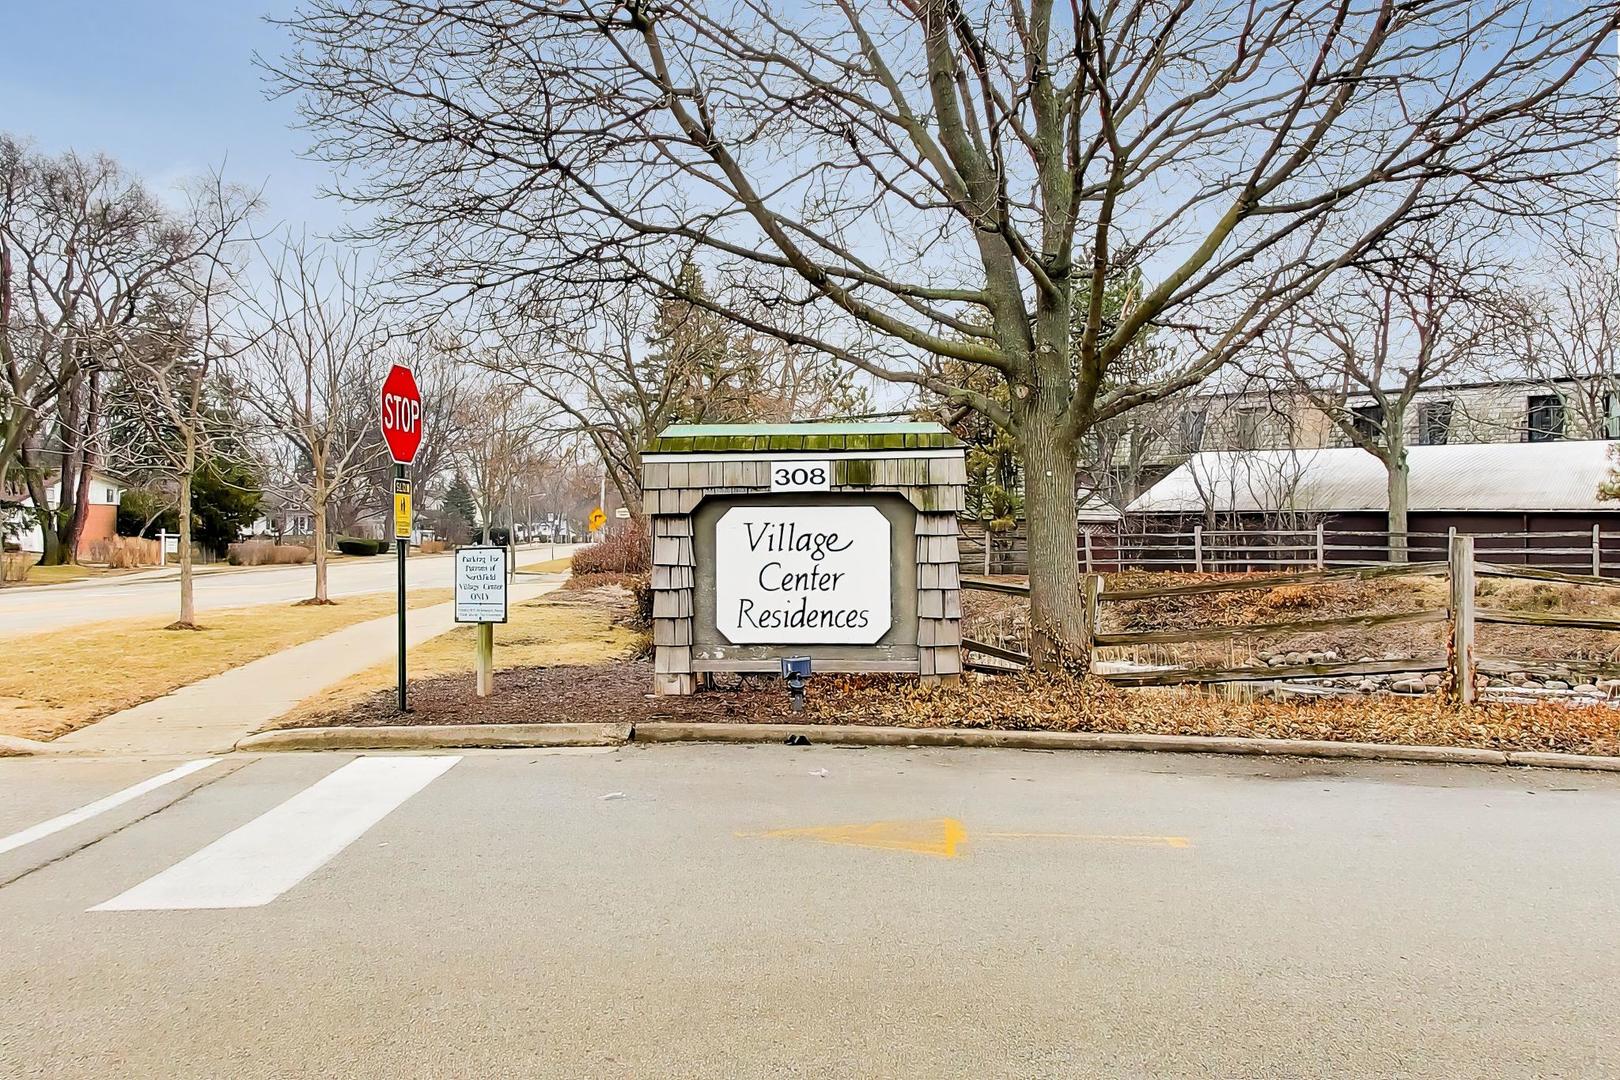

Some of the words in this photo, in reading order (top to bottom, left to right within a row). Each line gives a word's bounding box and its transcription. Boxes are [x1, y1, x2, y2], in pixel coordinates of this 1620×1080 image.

[384, 392, 419, 431] STOP
[775, 468, 826, 486] 308
[743, 522, 854, 561] Village
[759, 562, 845, 591] Center
[737, 597, 869, 629] Residences
